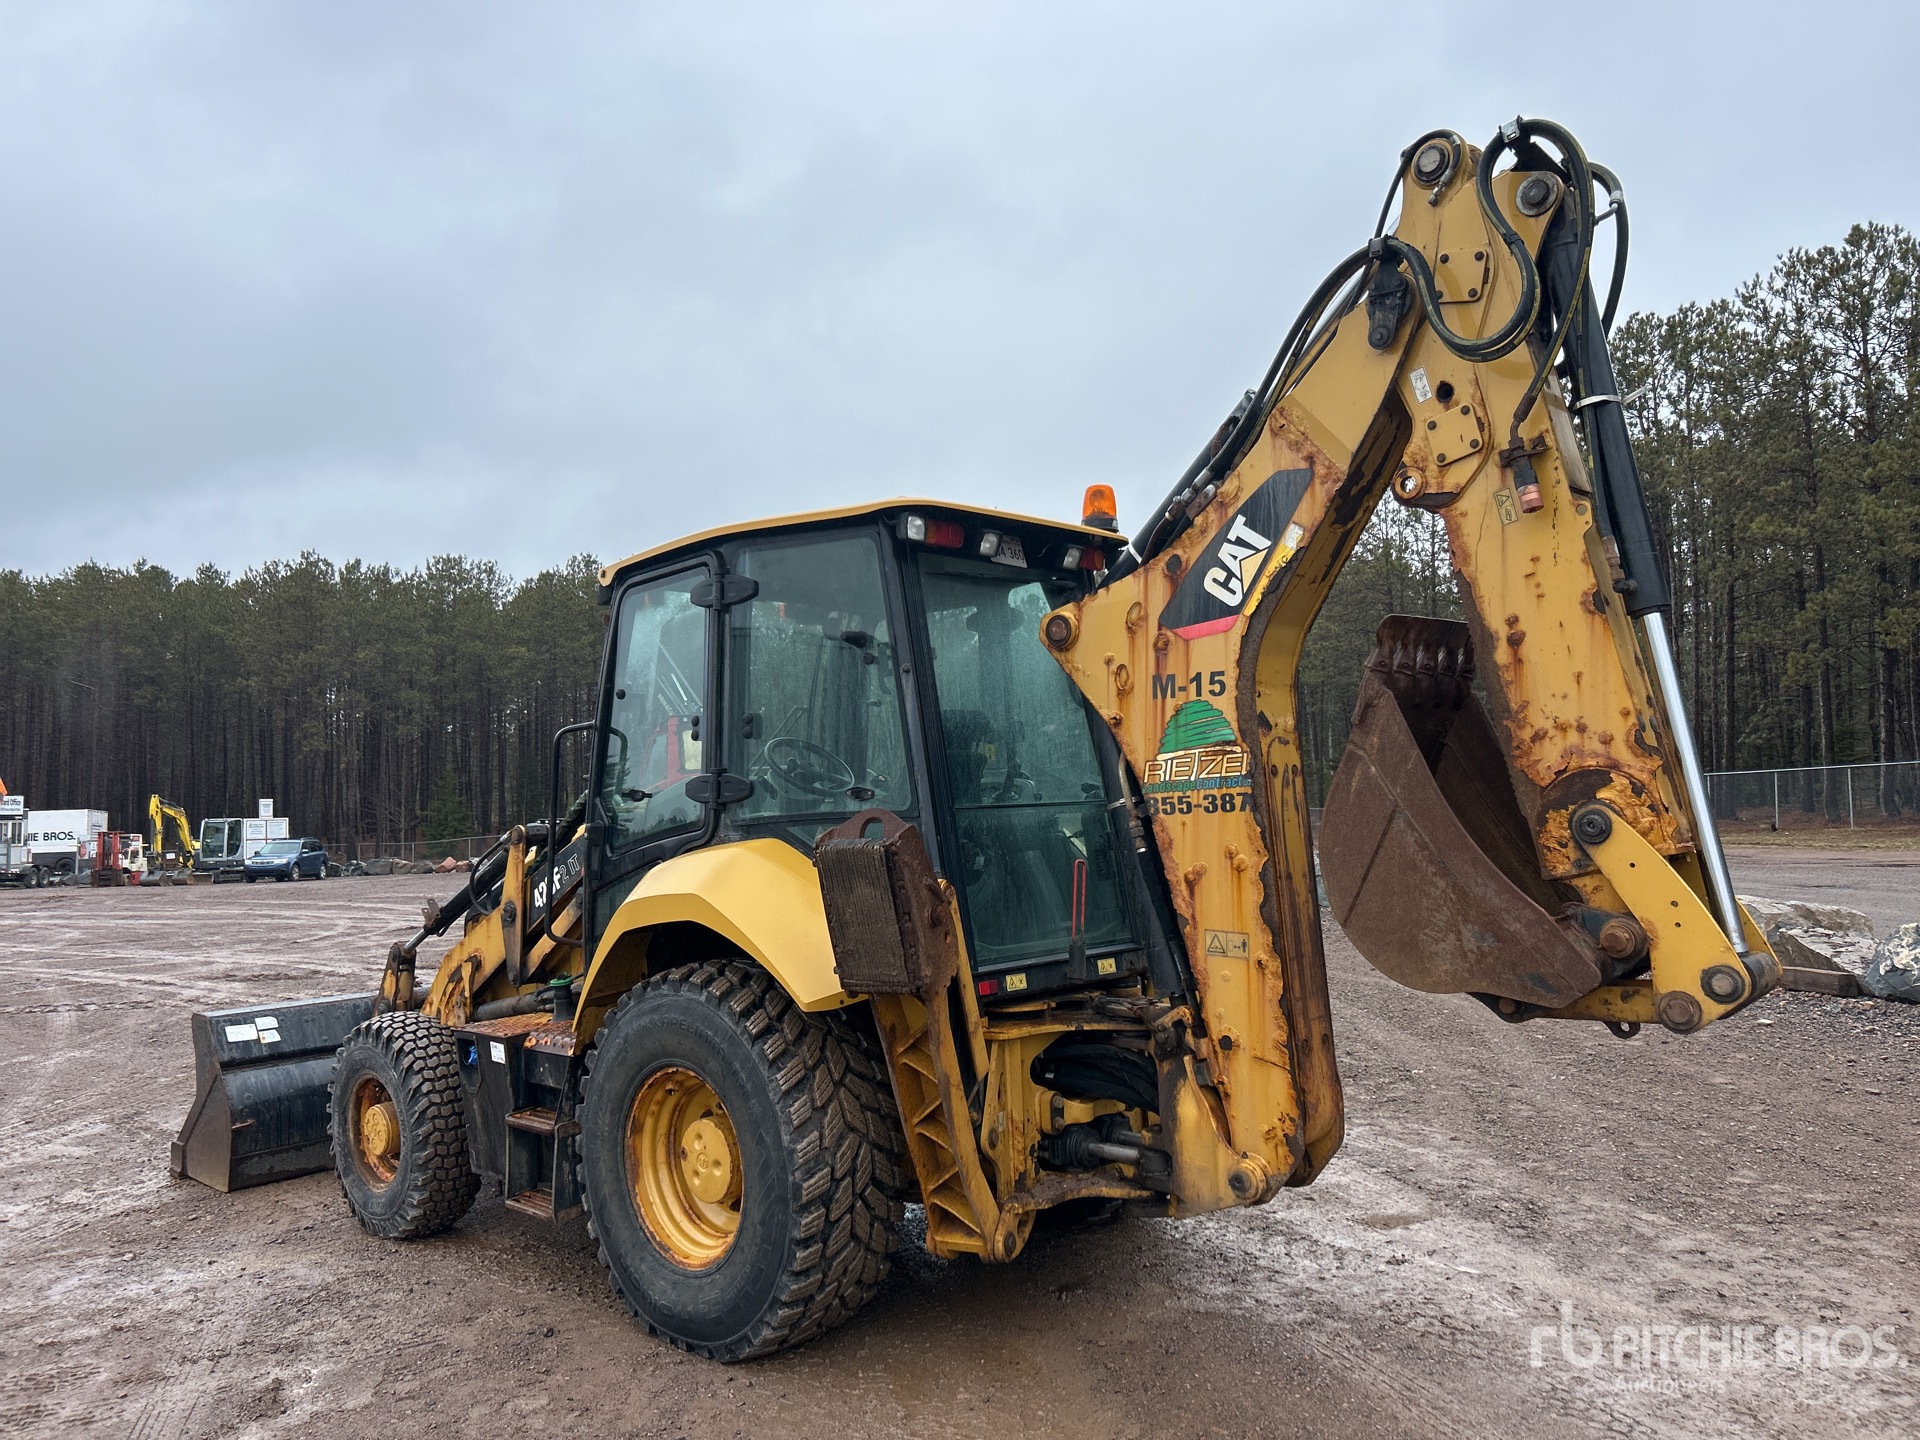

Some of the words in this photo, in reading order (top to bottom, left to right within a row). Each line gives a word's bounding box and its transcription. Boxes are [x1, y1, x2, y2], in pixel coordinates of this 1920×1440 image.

[1204, 514, 1272, 607] CAT
[1152, 671, 1226, 699] M-15
[43, 831, 76, 841] BROS.
